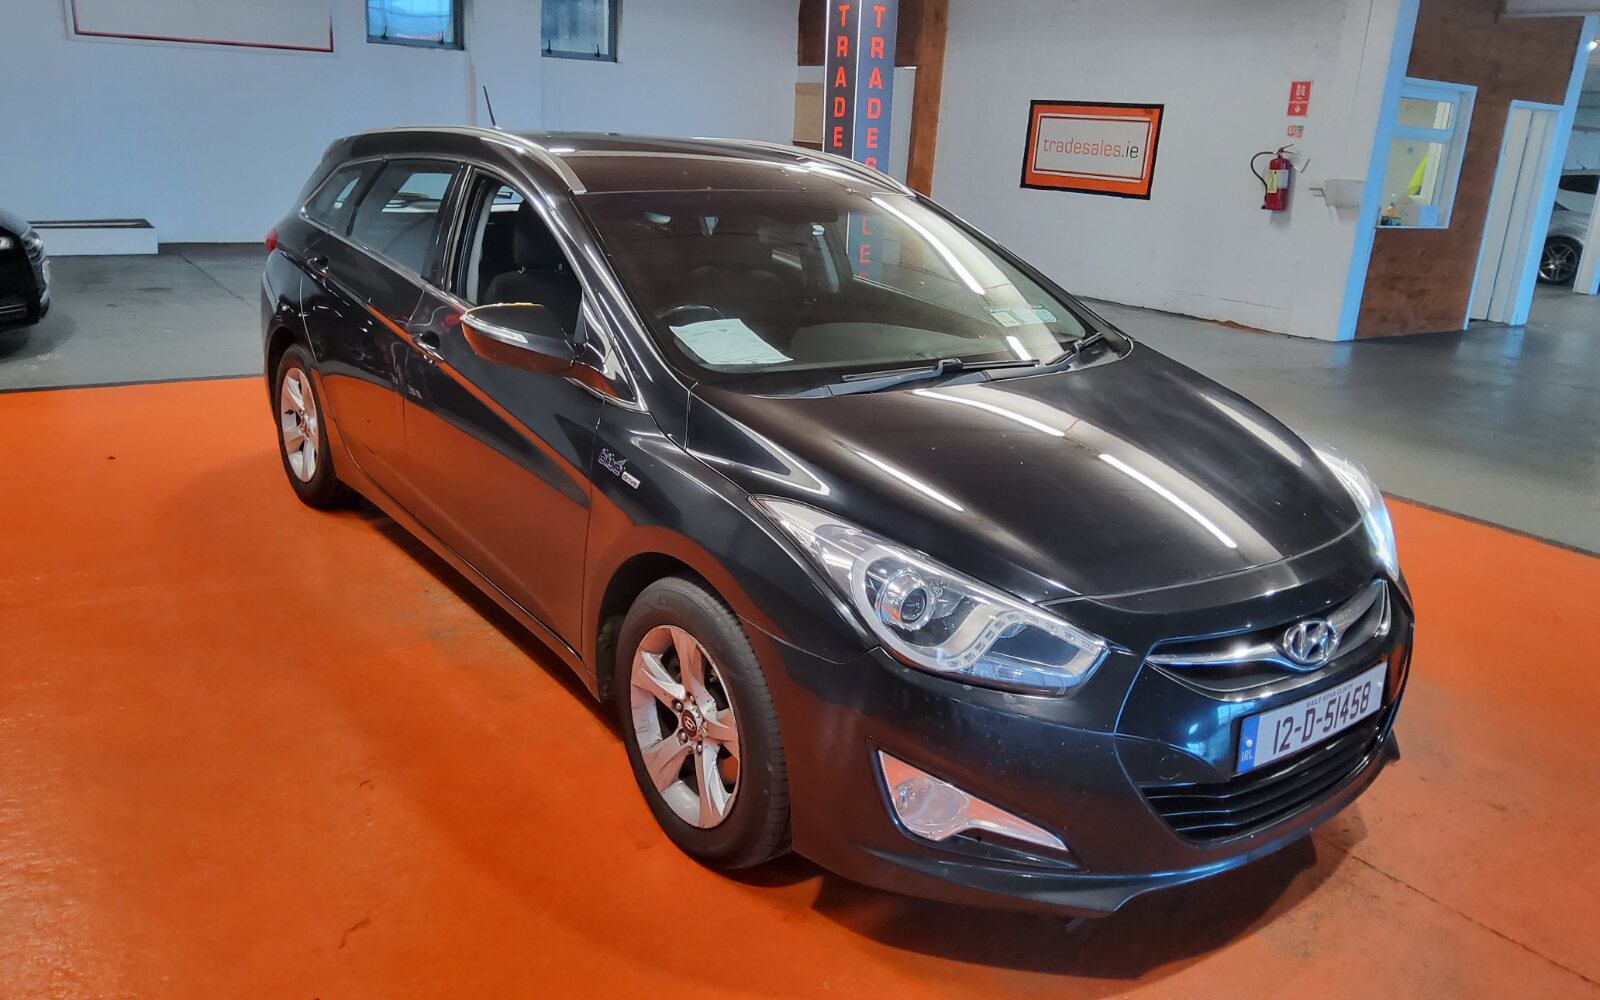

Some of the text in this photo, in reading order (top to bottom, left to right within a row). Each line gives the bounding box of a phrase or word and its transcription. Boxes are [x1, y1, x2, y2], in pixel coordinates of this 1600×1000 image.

[1043, 137, 1139, 159] tradesales.ie
[1272, 681, 1372, 755] 12-D-51458
[1241, 749, 1254, 762] IRL
